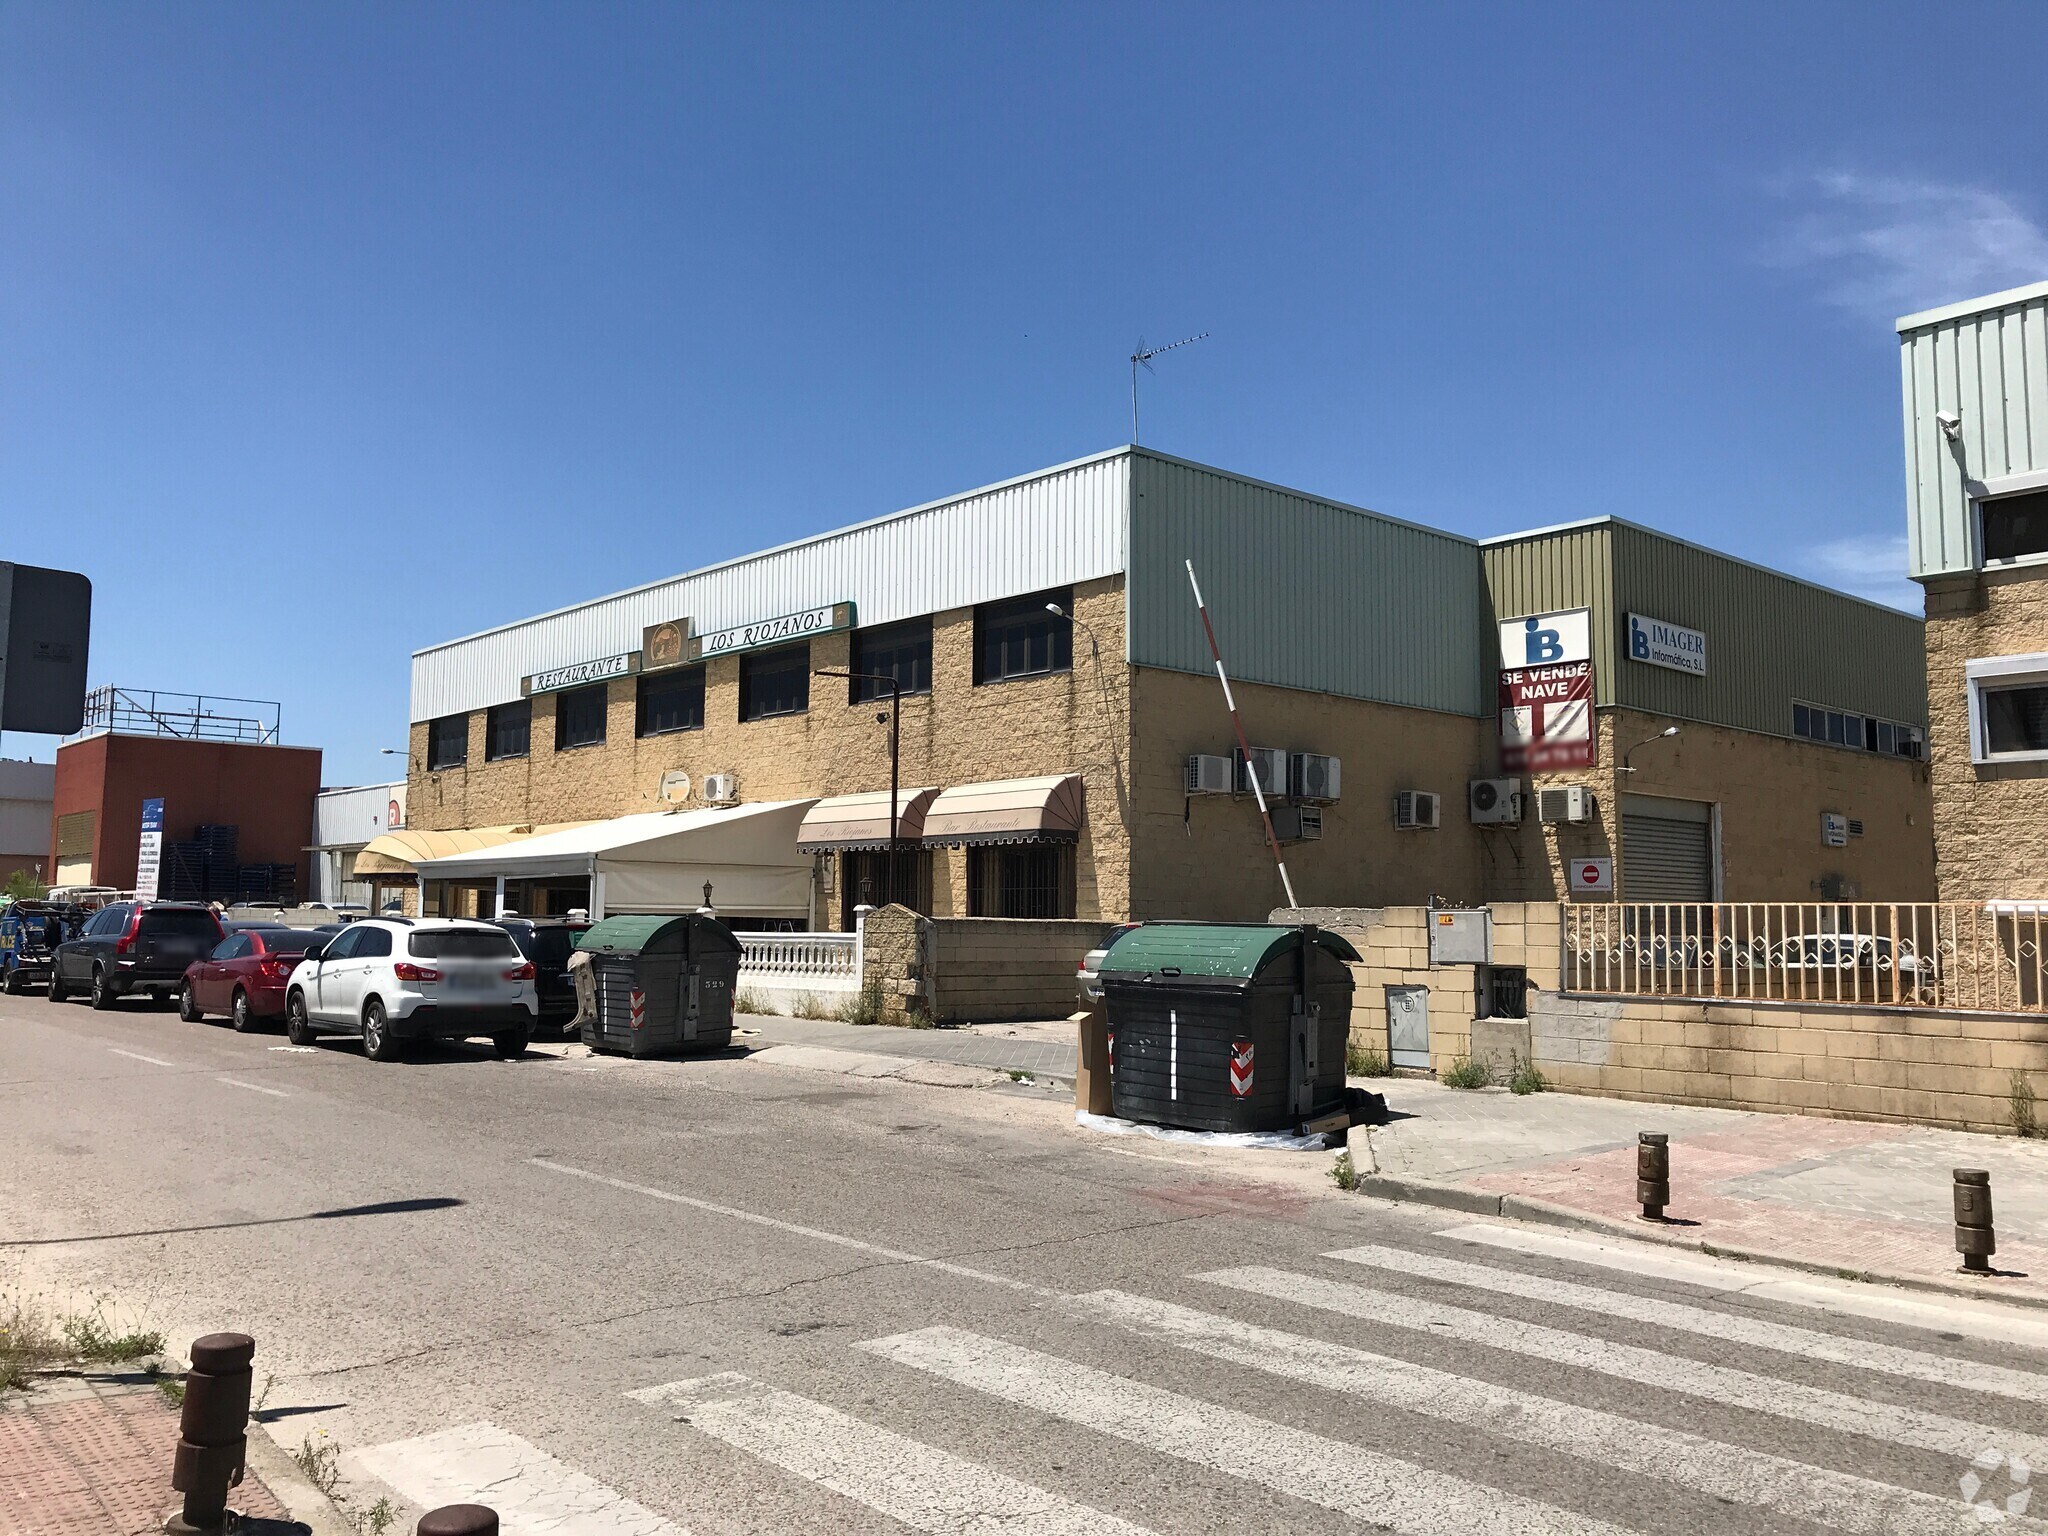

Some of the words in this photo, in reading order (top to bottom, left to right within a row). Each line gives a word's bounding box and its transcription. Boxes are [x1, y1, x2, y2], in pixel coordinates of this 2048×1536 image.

[709, 631, 735, 652] LOS
[743, 611, 825, 646] RIOJANOS
[1652, 624, 1704, 655] IMAGER
[536, 657, 623, 691] RESTAURANTE
[1501, 670, 1524, 686] SE
[1528, 662, 1589, 683] VENDE
[1521, 682, 1569, 700] NAVE
[938, 819, 961, 833] Bar
[965, 817, 1021, 832] Restaurante
[705, 980, 725, 989] 529
